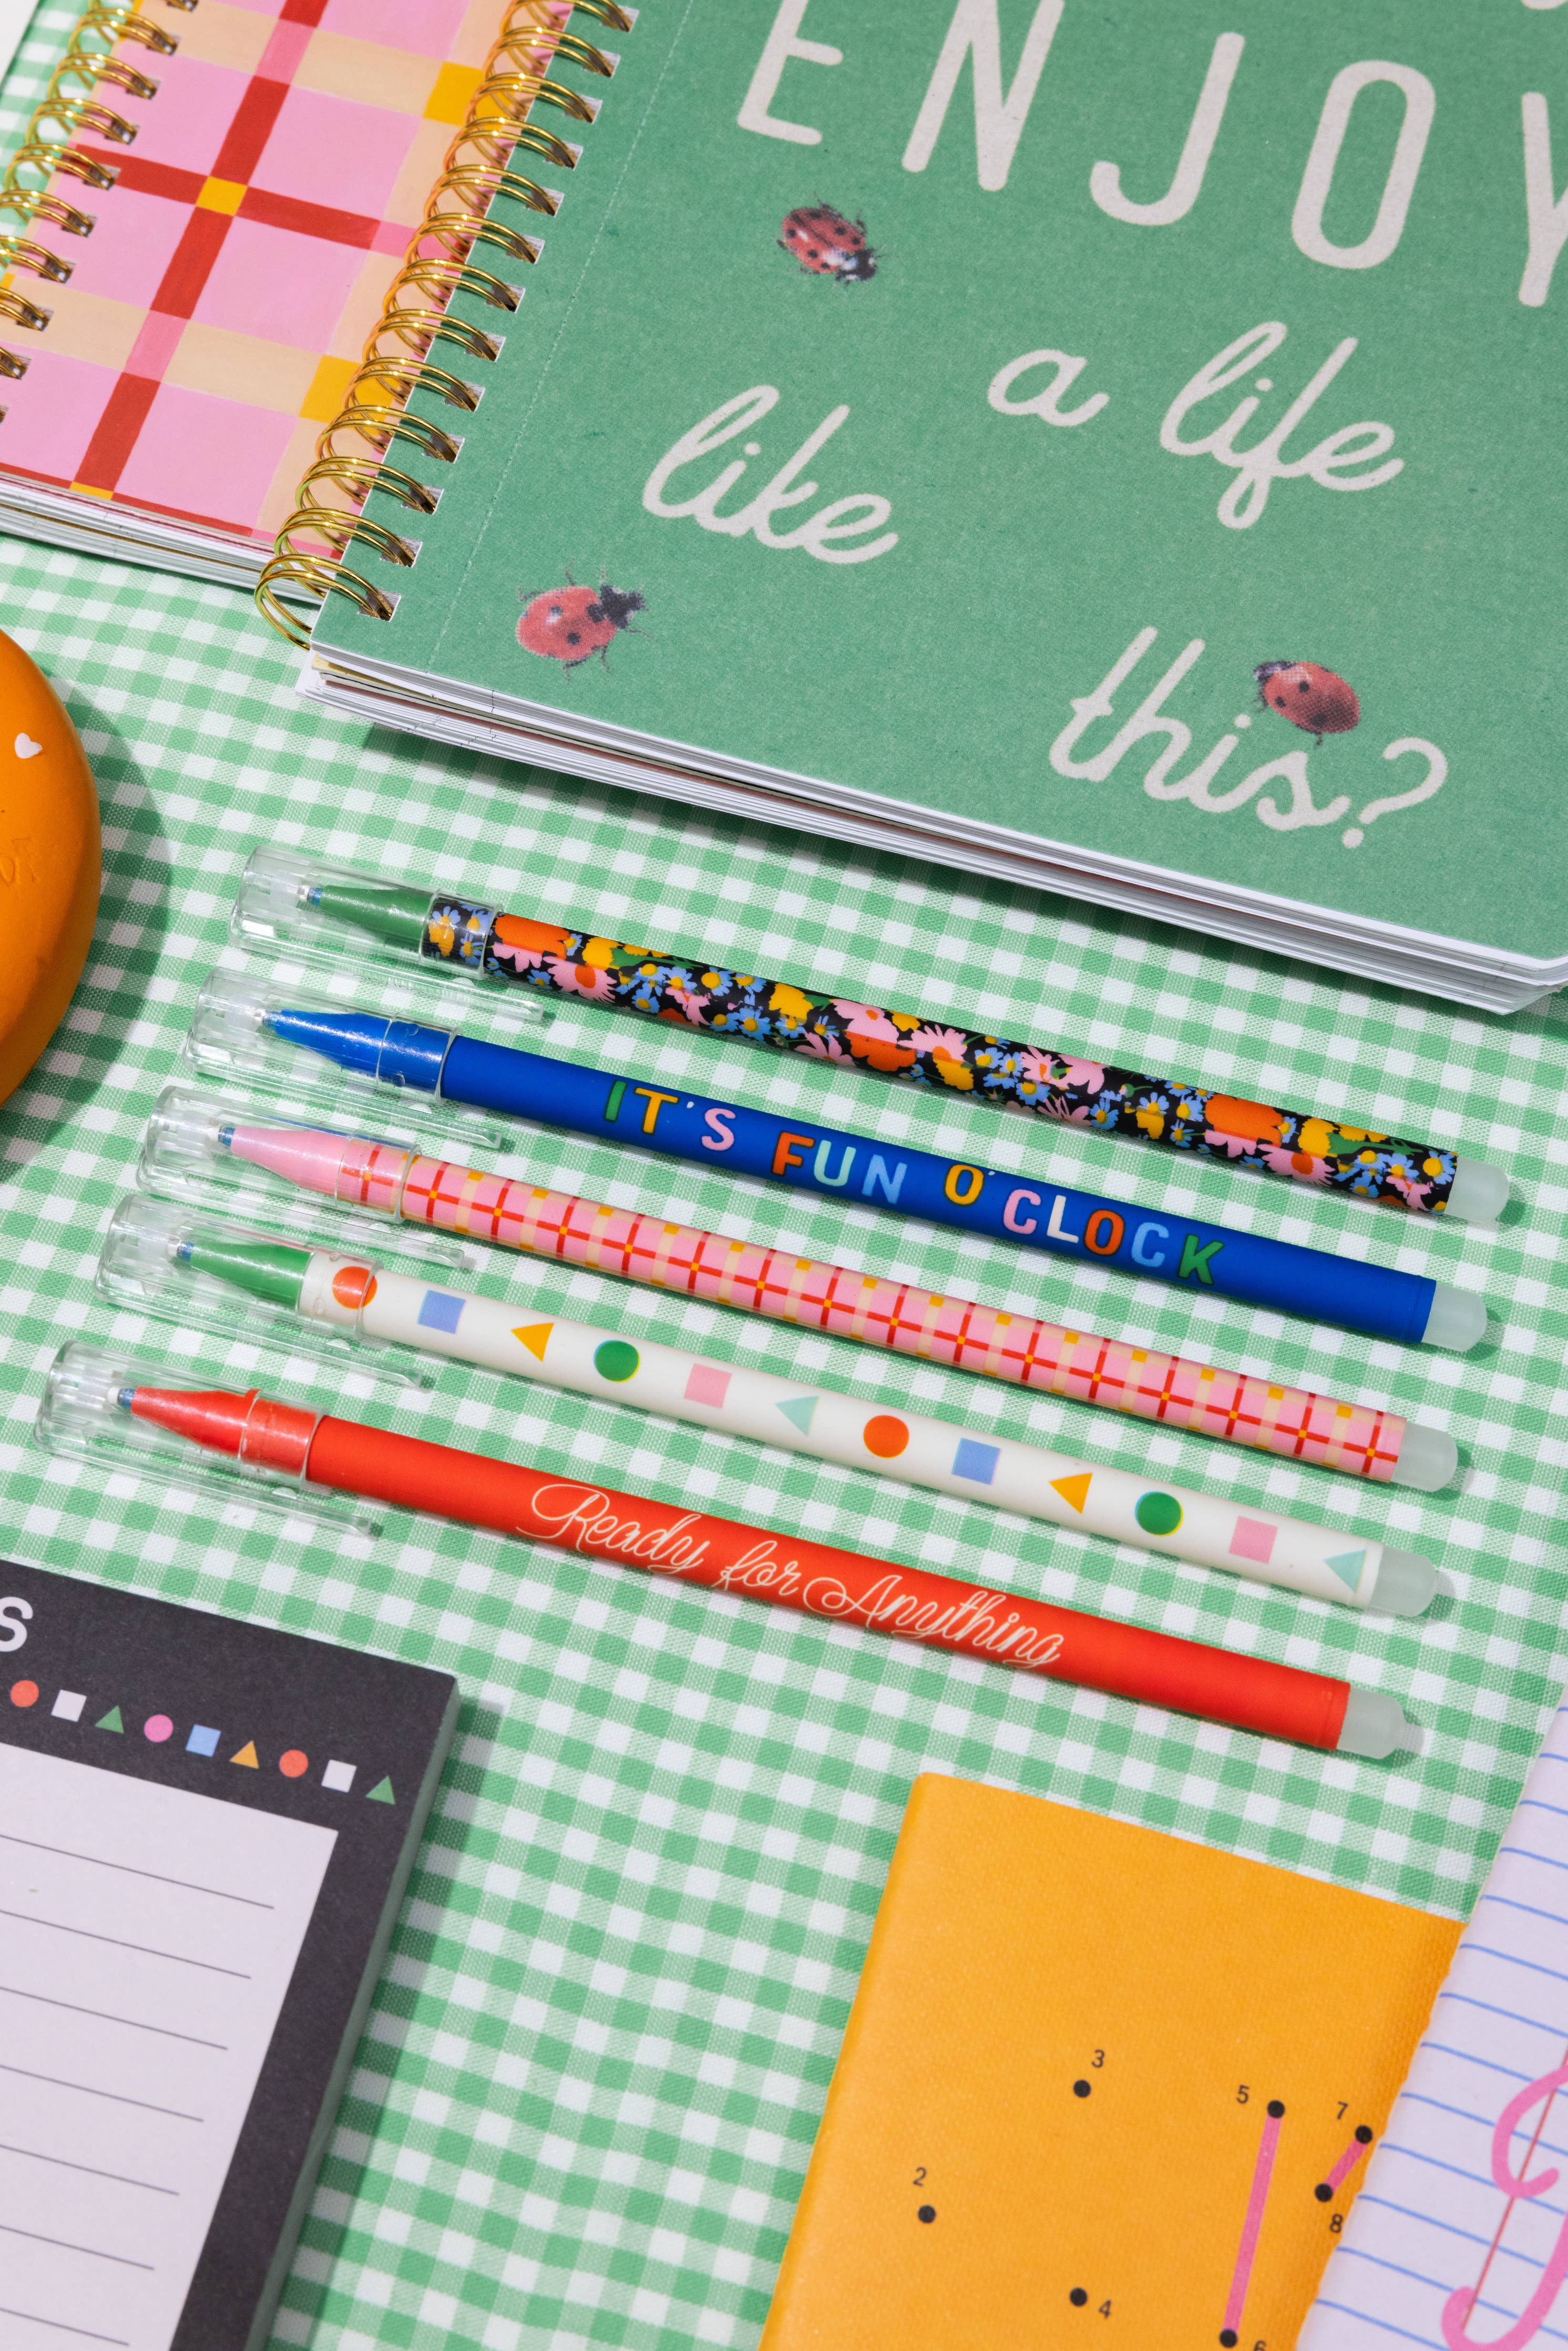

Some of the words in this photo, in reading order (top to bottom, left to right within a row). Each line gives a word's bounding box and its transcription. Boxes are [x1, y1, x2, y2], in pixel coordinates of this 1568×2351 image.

[736, 0, 1568, 308] ENJOY
[641, 384, 900, 566] like
[987, 349, 1111, 427] a
[1158, 321, 1405, 530] life
[1048, 625, 1449, 849] this?
[605, 1080, 736, 1151] IT'S
[771, 1130, 908, 1204] FUN
[945, 1163, 1225, 1286] O'CLOCK
[516, 1484, 711, 1574] Ready
[711, 1540, 802, 1593] for
[803, 1575, 1064, 1668] Anything
[1092, 2049, 1105, 2069] 3
[1236, 2084, 1249, 2104] 5
[1336, 2101, 1349, 2120] 7
[913, 2166, 927, 2186] 2
[1329, 2213, 1344, 2234] 8
[1098, 2299, 1112, 2318] 4
